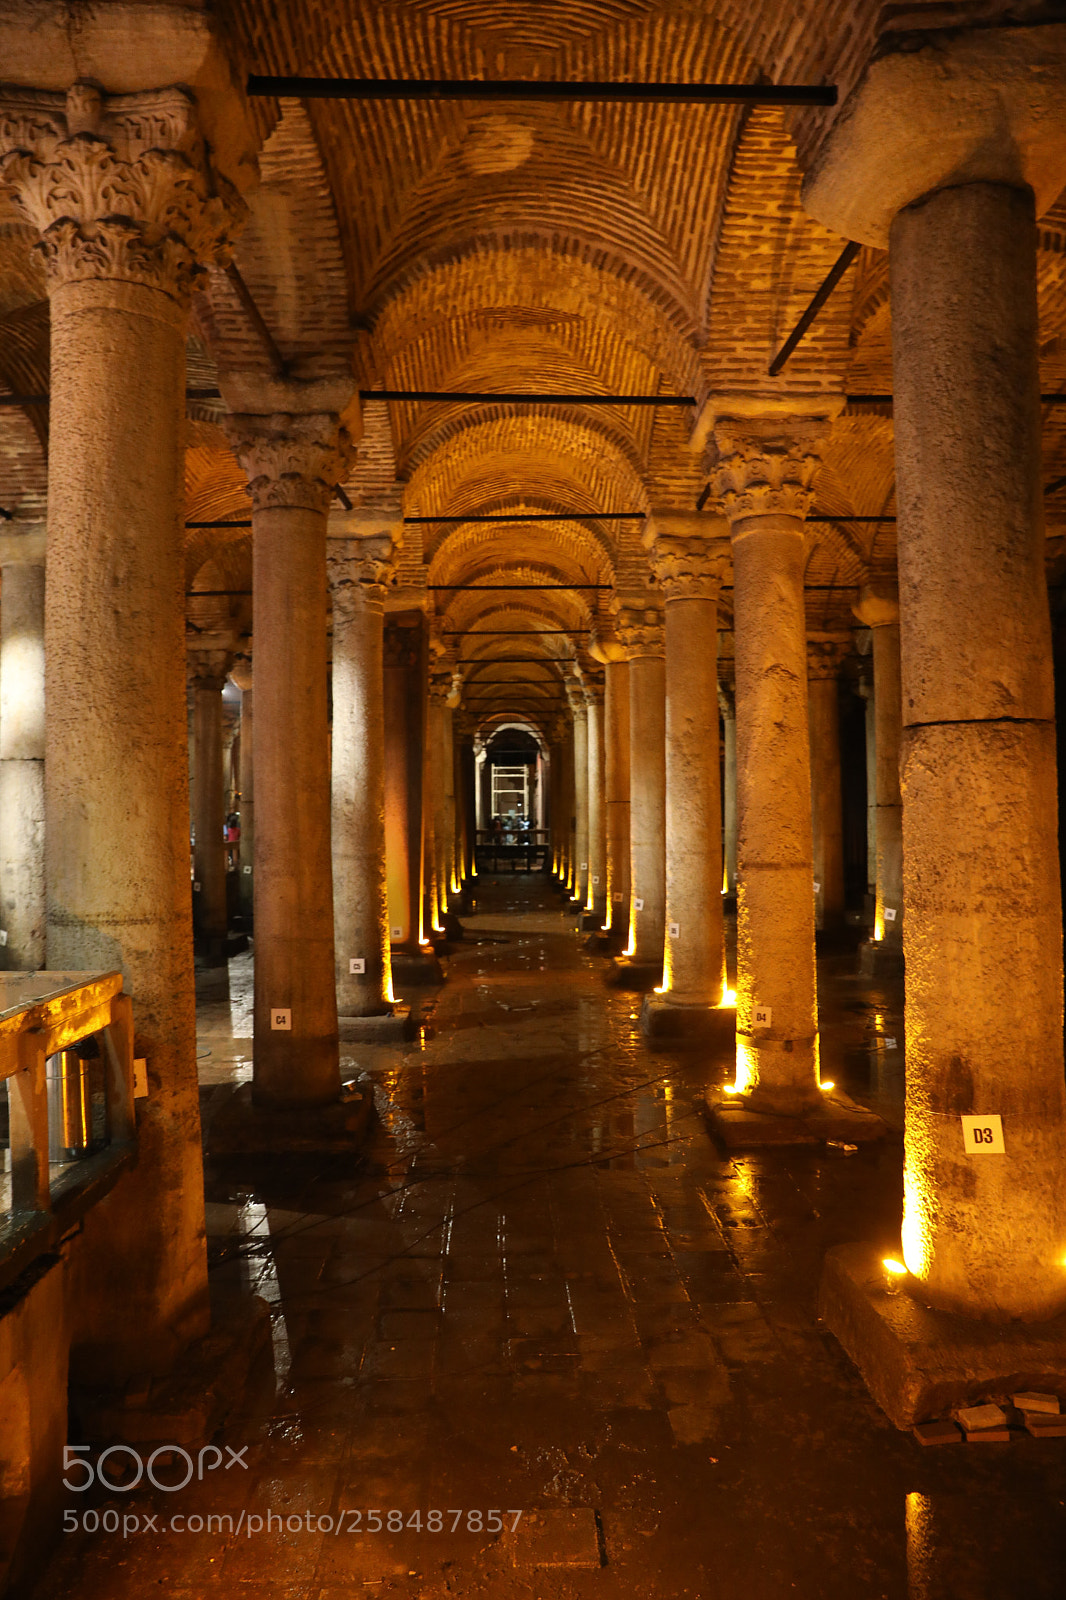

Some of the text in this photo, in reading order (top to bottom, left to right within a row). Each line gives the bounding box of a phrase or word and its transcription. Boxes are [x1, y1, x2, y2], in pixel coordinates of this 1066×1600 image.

[275, 1015, 286, 1025] C4
[756, 1012, 766, 1022] D4
[973, 1127, 993, 1144] D3
